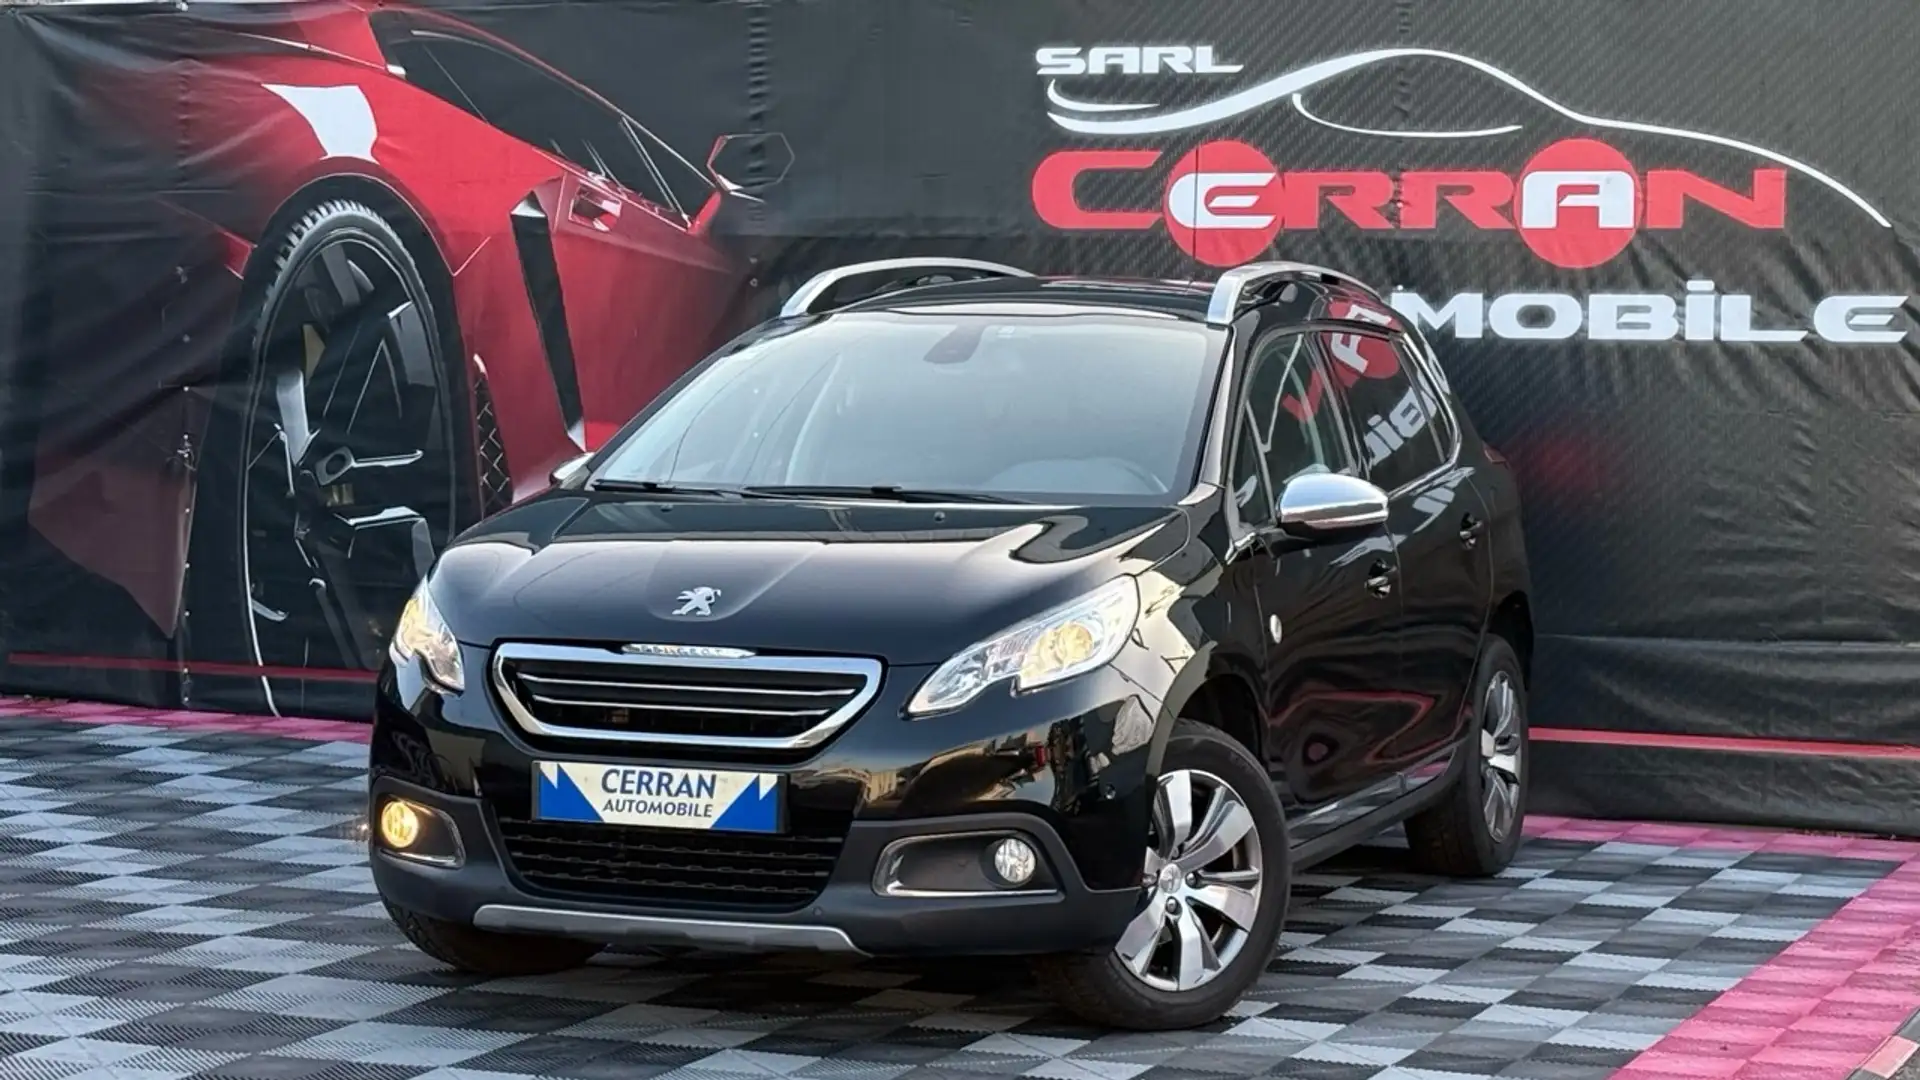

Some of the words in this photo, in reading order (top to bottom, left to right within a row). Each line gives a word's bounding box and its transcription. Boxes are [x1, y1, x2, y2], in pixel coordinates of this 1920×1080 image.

[1036, 45, 1244, 75] SARL
[1032, 149, 1787, 231] CERRAN
[601, 768, 717, 799] CERRAN
[603, 799, 713, 818] AUTOMOBILE
